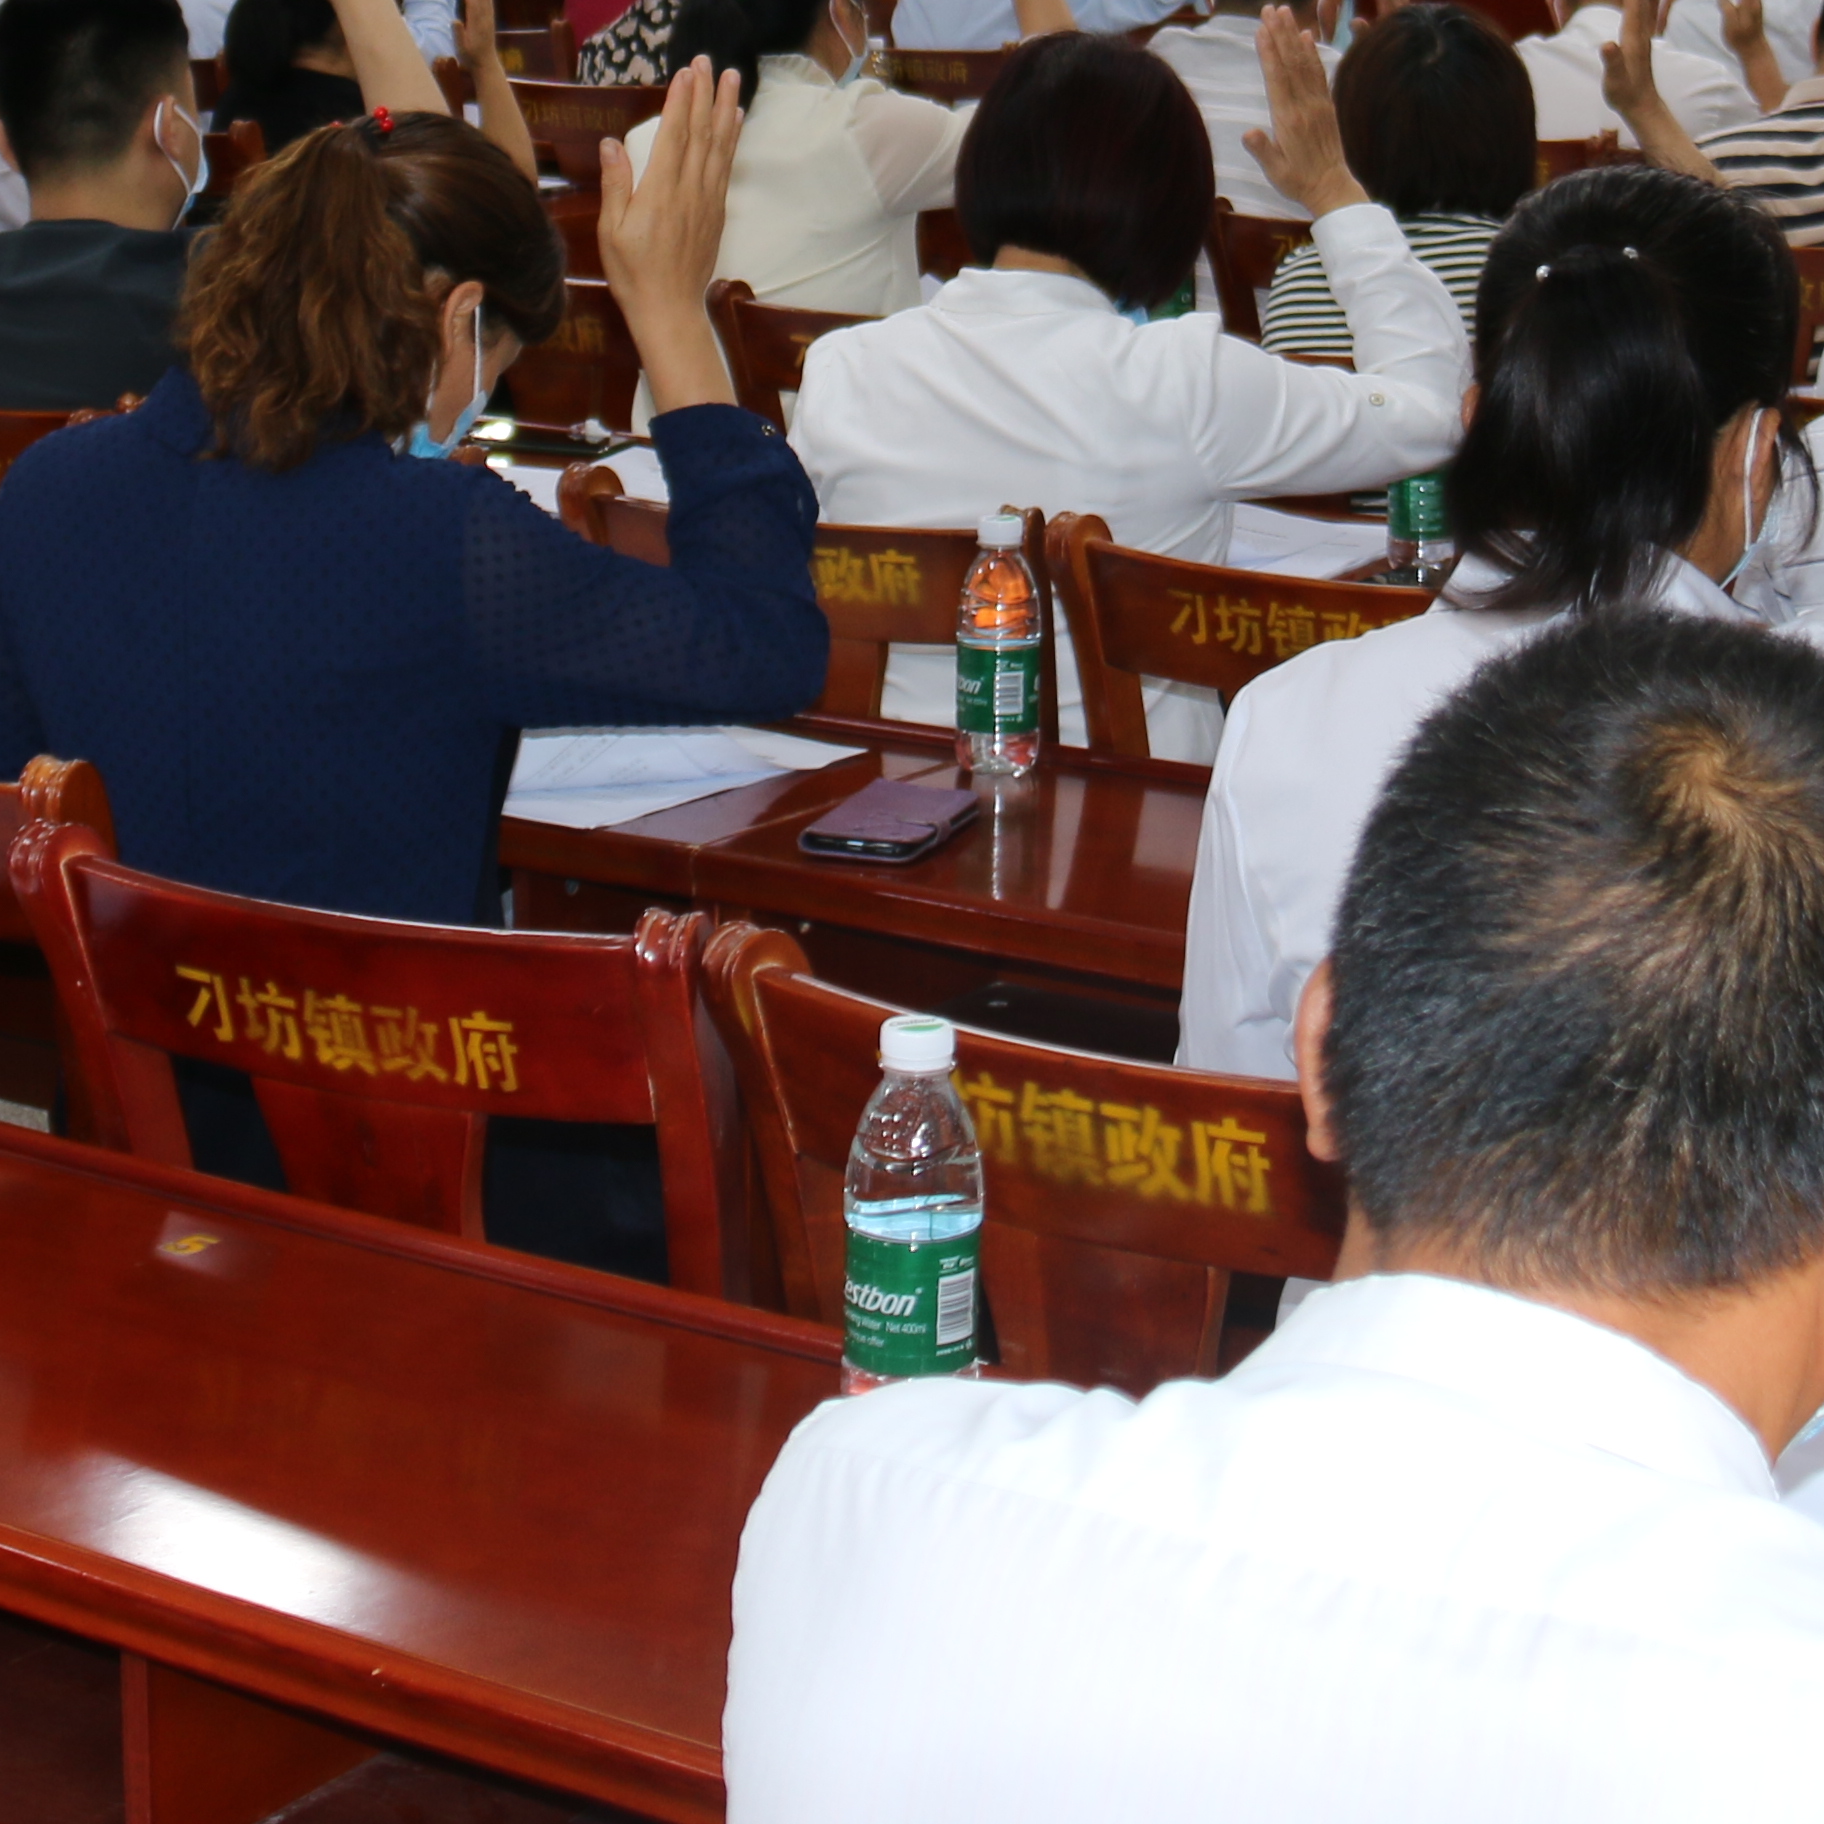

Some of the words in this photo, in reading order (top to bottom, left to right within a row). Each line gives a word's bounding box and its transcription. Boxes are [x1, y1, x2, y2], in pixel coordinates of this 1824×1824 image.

[1167, 588, 1418, 657] 刁坊镇政
[175, 965, 522, 1095] 刁坊镇政府
[946, 1069, 1272, 1214] 坊镇政府
[844, 1279, 917, 1317] estbon
